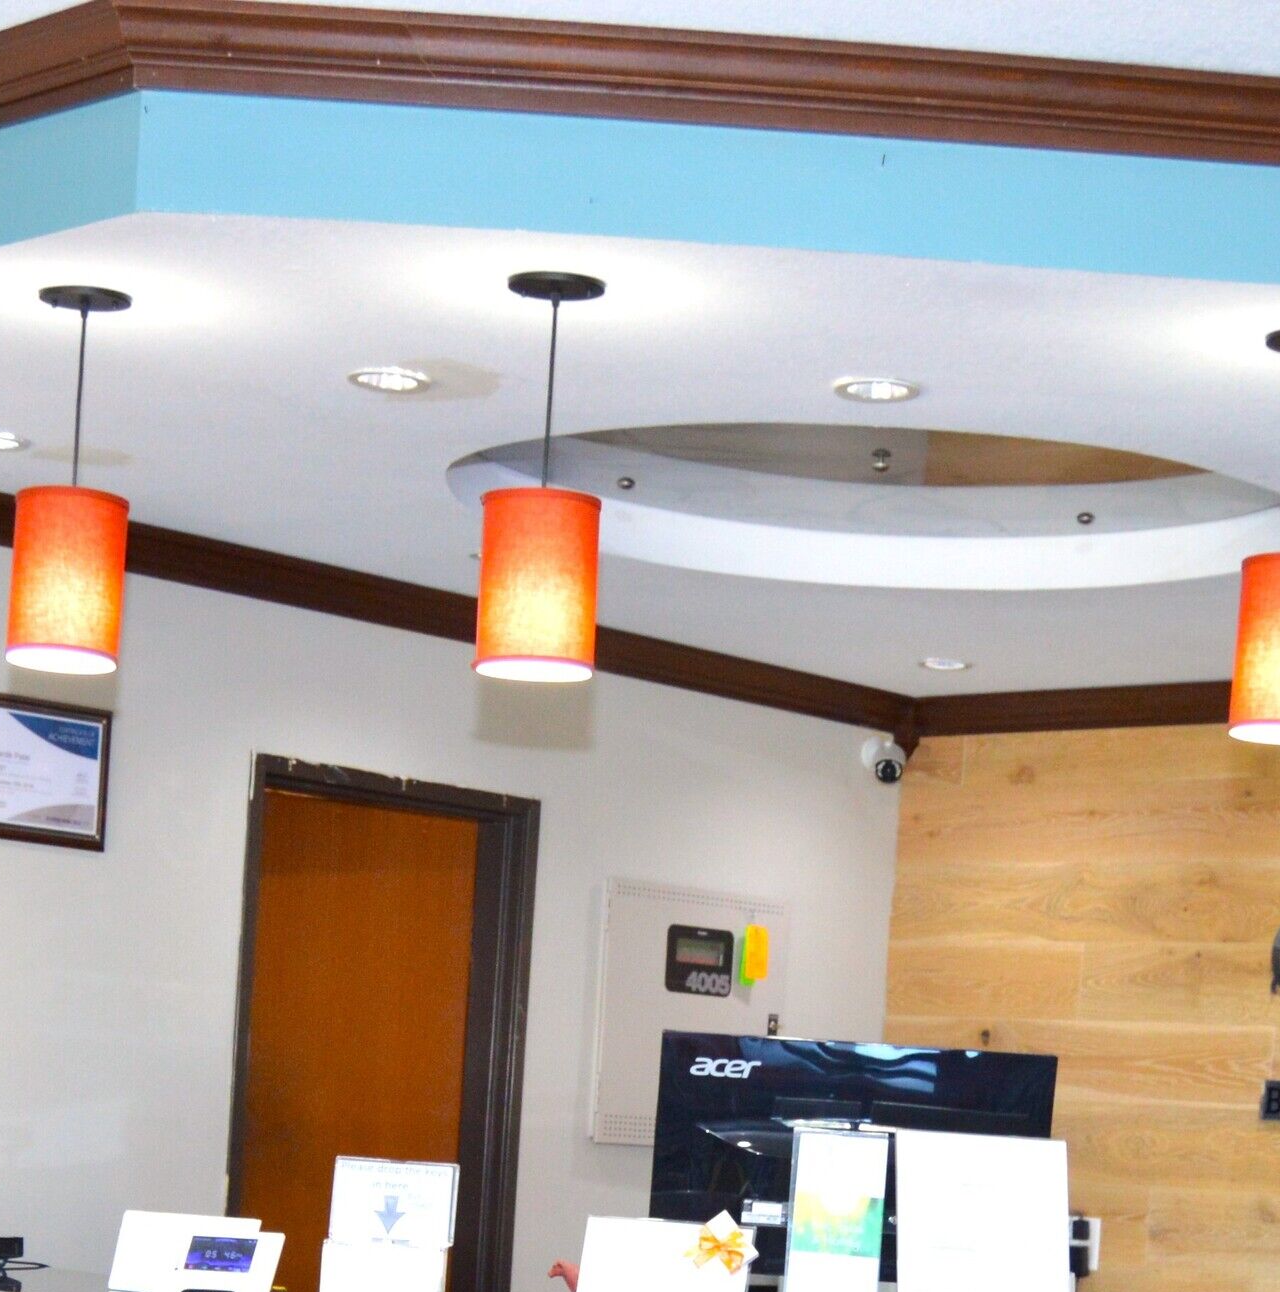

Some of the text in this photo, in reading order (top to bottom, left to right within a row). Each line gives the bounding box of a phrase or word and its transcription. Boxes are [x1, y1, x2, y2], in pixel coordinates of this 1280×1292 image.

[690, 1057, 762, 1078] acer
[340, 1160, 374, 1173] Please
[377, 1164, 402, 1175] drop
[405, 1167, 421, 1175] the
[372, 1181, 409, 1190] in here
